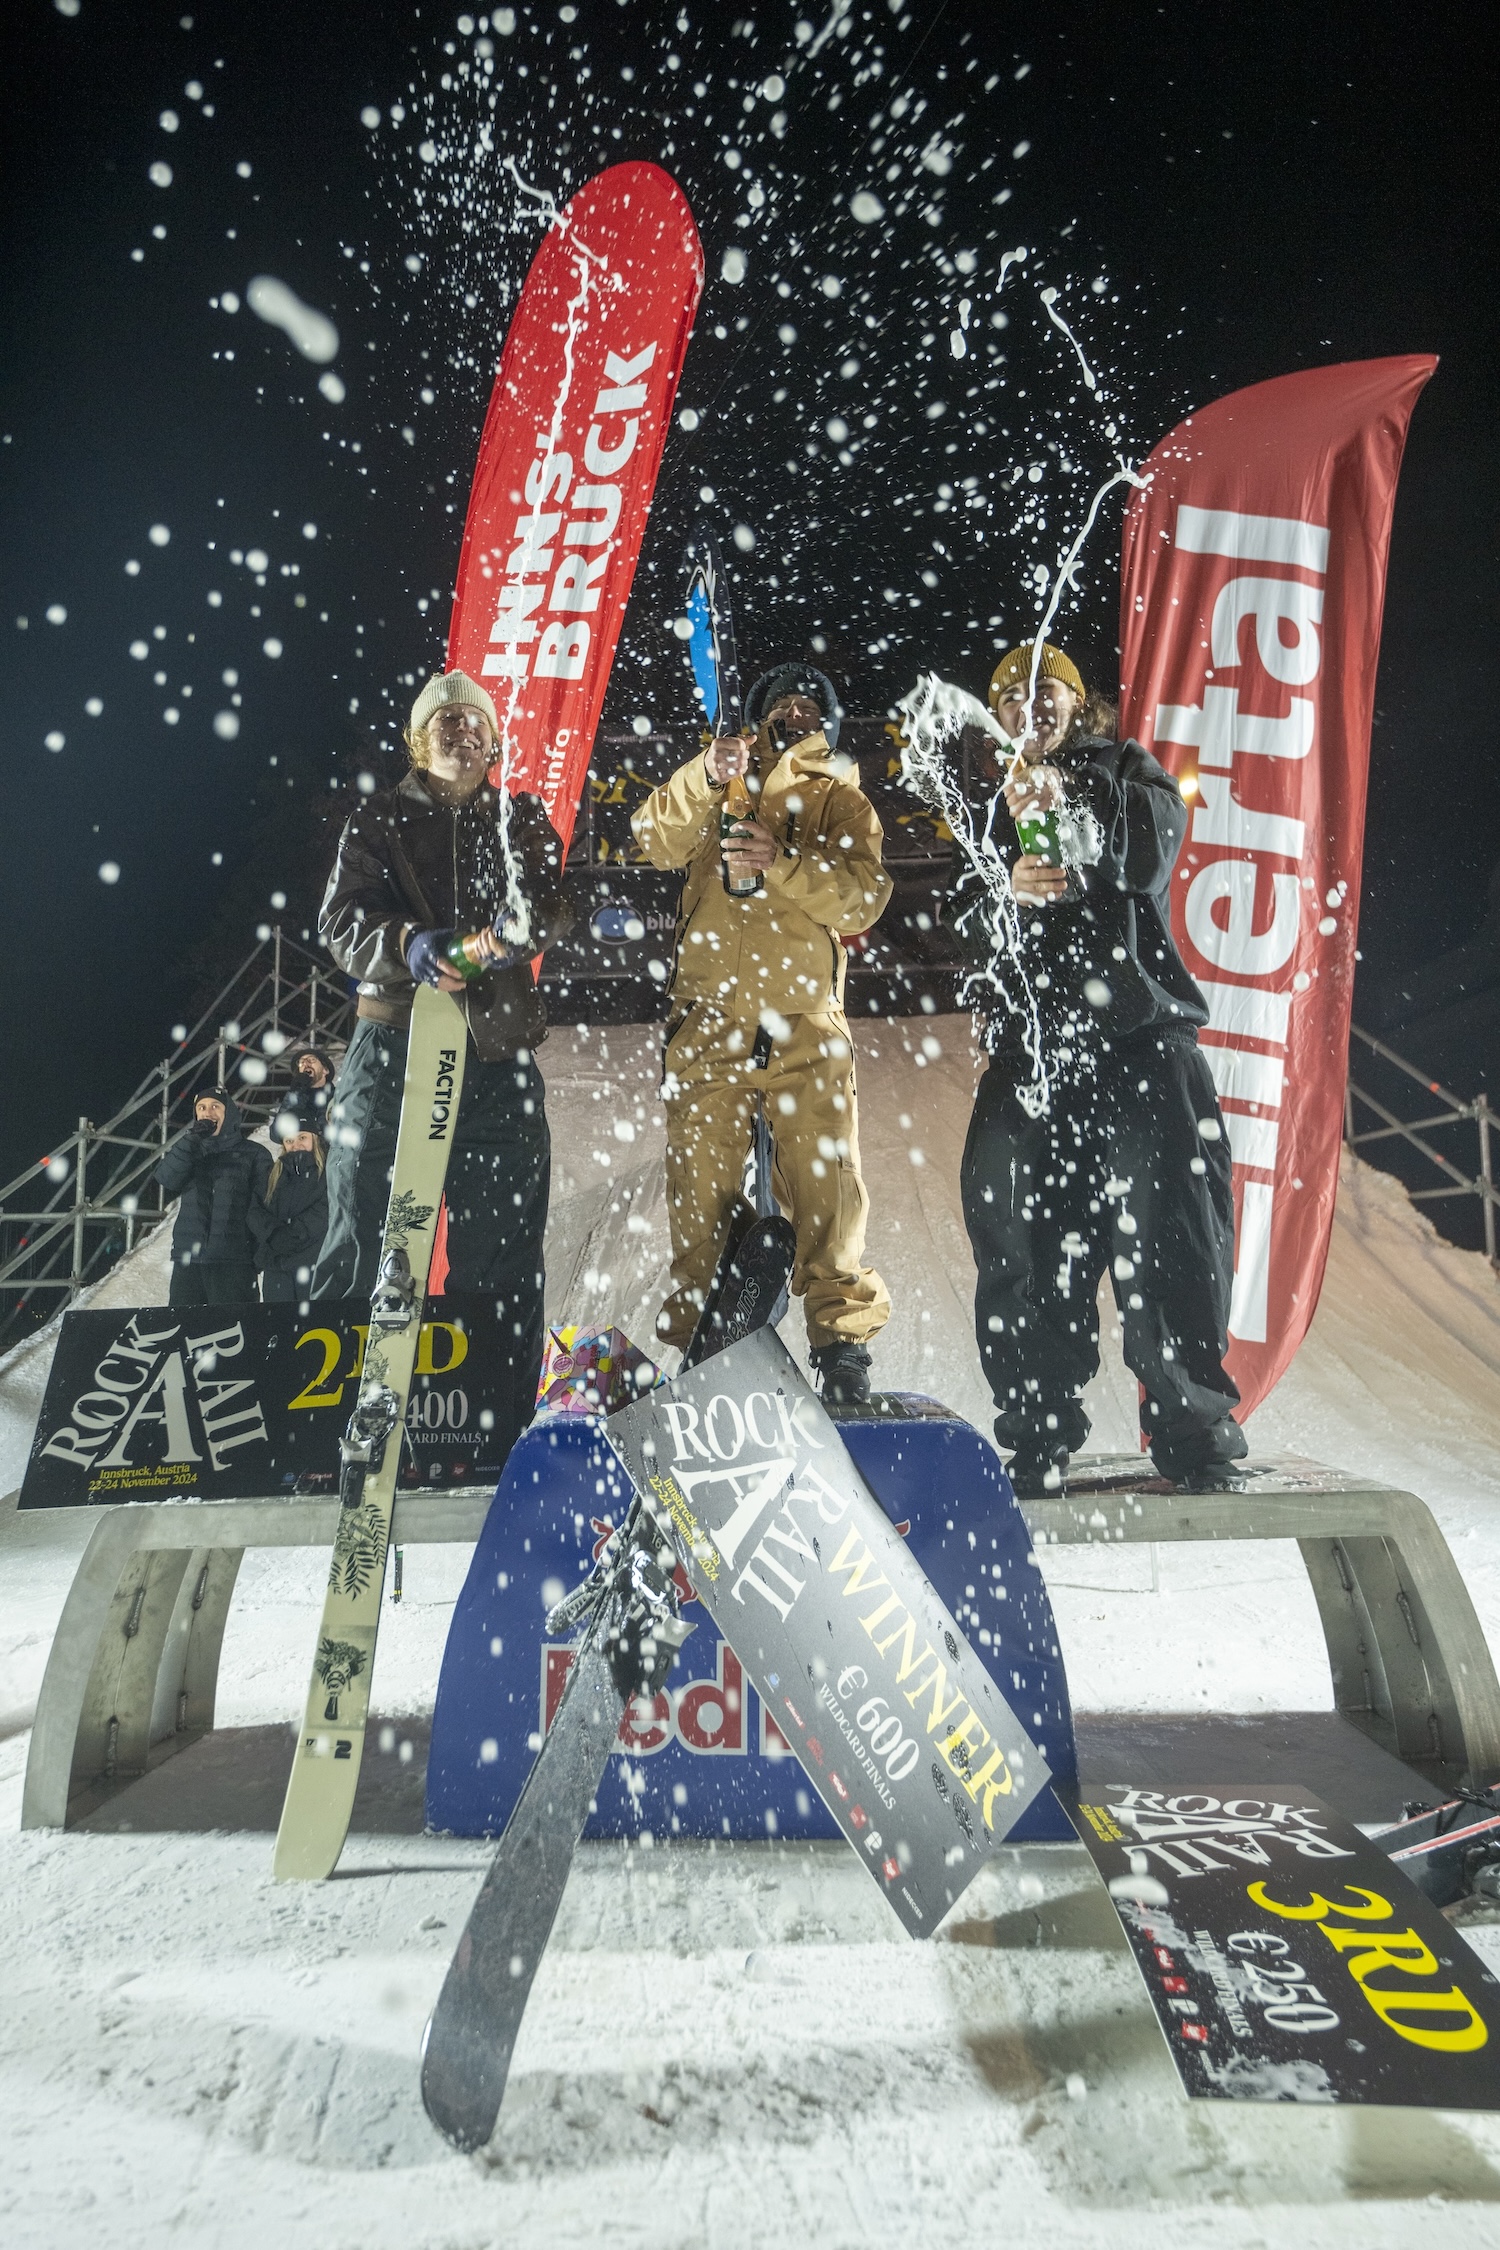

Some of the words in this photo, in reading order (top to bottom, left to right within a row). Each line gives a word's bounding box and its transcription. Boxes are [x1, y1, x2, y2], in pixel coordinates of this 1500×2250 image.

[533, 341, 657, 679] BRUCK
[1154, 505, 1331, 1343] llertal
[428, 1050, 456, 1140] FACTION
[39, 1314, 181, 1472] ROCK
[94, 1351, 203, 1467] A
[185, 1321, 268, 1471] RAIL
[441, 1431, 481, 1443] FINALS
[661, 1392, 825, 1463] ROCK
[100, 1467, 151, 1479] Innsbruck,
[155, 1463, 190, 1475] Austria
[120, 1477, 171, 1488] November
[173, 1473, 197, 1484] 2024
[663, 1477, 698, 1531] Innsbruck
[670, 1457, 797, 1571] A
[649, 1475, 672, 1506] 22-24
[669, 1505, 698, 1553] Novemb
[698, 1556, 720, 1582] 2024
[731, 1459, 851, 1623] RAIL
[828, 1521, 1013, 1832] WINNER
[837, 1665, 868, 1700] €
[856, 1697, 919, 1781] 600
[334, 1740, 352, 1759] 2
[819, 1683, 865, 1759] WILDCARD
[861, 1757, 896, 1810] FINALS
[1114, 1789, 1328, 1830] ROCK
[1121, 1828, 1356, 1878] RAIL
[1242, 1959, 1340, 2033] 250
[1247, 1880, 1488, 2052] 3RD
